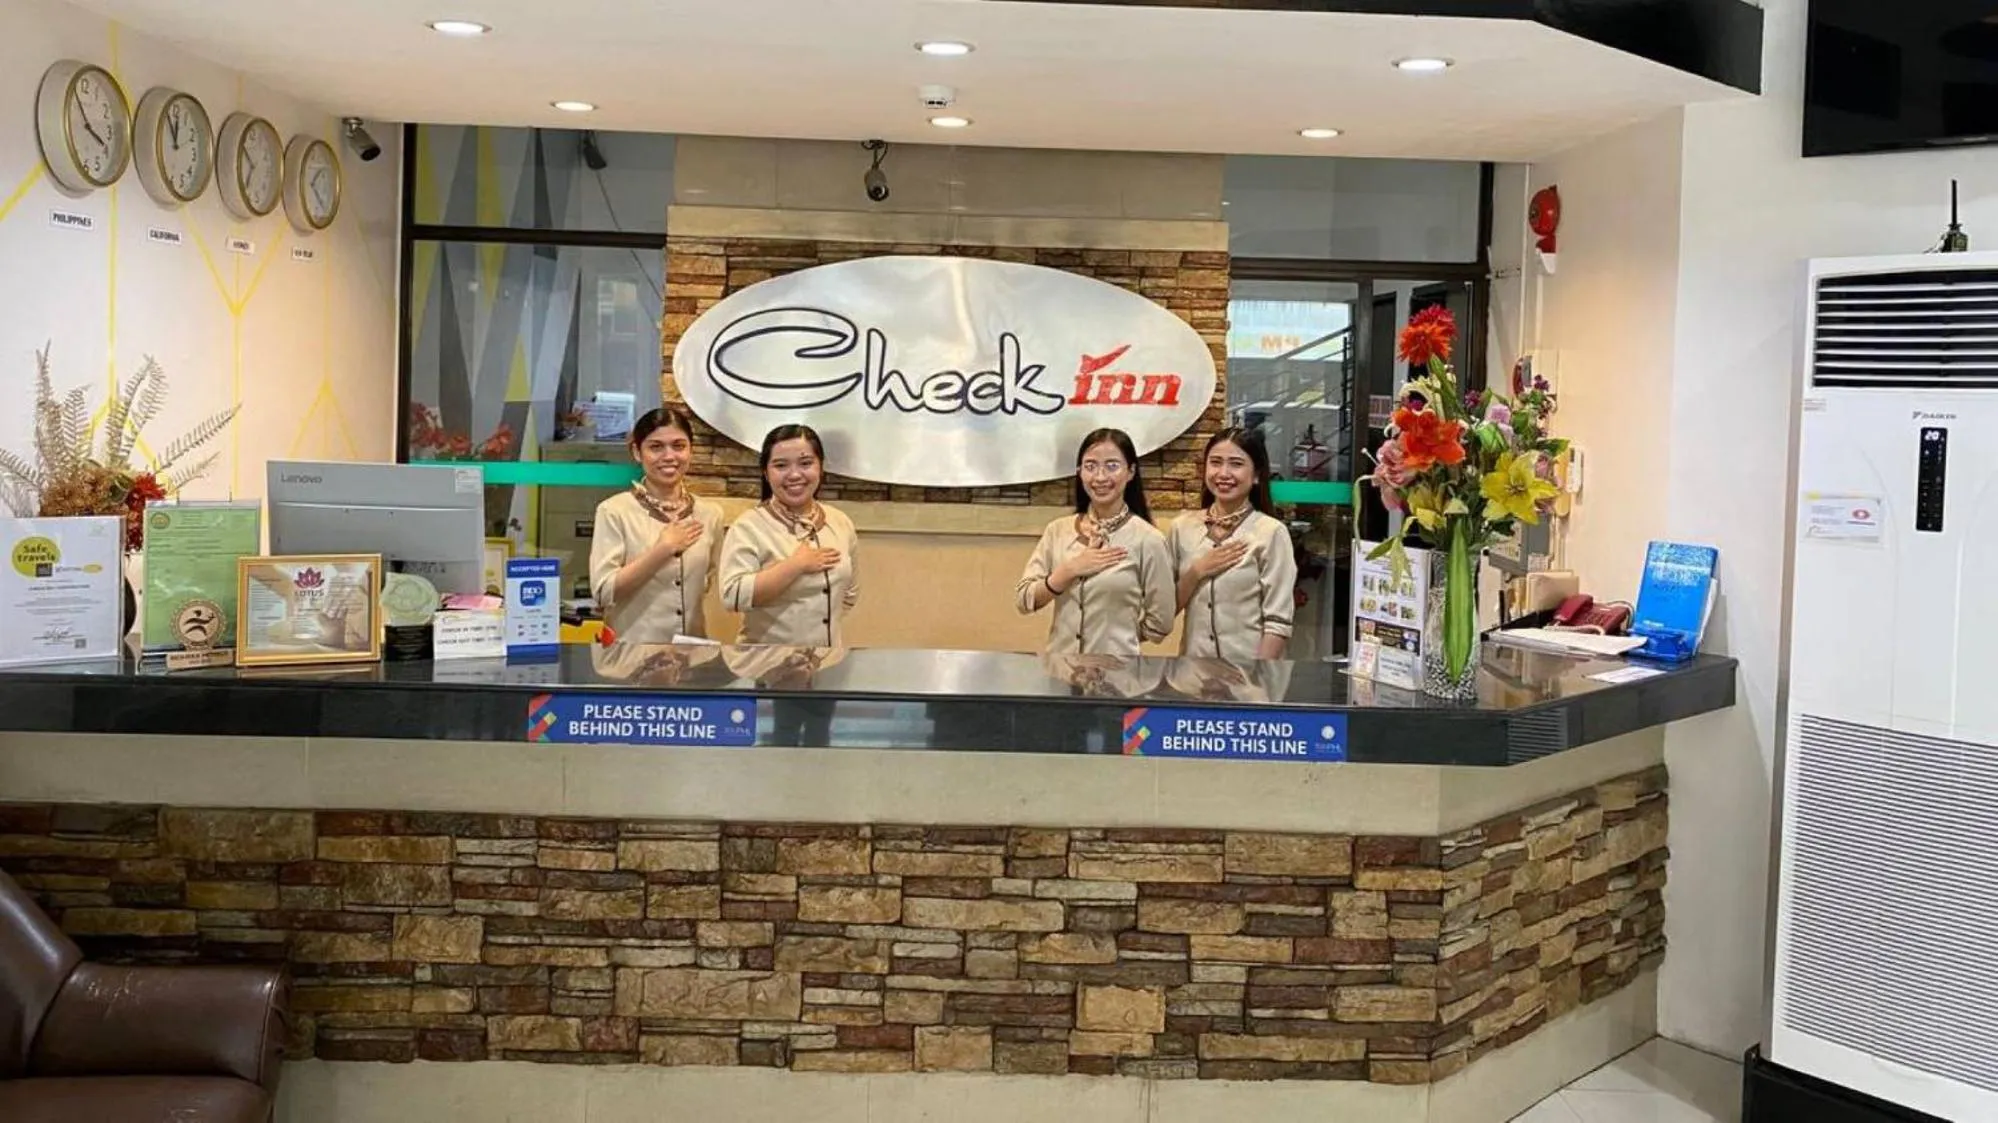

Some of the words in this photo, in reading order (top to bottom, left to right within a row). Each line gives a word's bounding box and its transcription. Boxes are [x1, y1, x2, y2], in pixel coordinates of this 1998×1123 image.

[53, 212, 92, 227] PHILIPPINES
[149, 229, 180, 241] CALIFORNIA
[707, 307, 1065, 415] Check
[280, 473, 323, 485] Lenovo
[23, 543, 48, 553] Safe
[17, 552, 56, 563] travels
[294, 589, 325, 598] LOTUS
[583, 704, 643, 720] PLEASE
[646, 705, 703, 722] STAND
[568, 720, 634, 737] BEHIND
[635, 722, 677, 738] THIS
[679, 724, 716, 739] LINE
[1176, 719, 1235, 736] PLEASE
[1238, 721, 1293, 738] STAND
[1161, 735, 1228, 752] BEHIND
[1230, 738, 1269, 753] THIS
[1271, 739, 1307, 755] LINE
